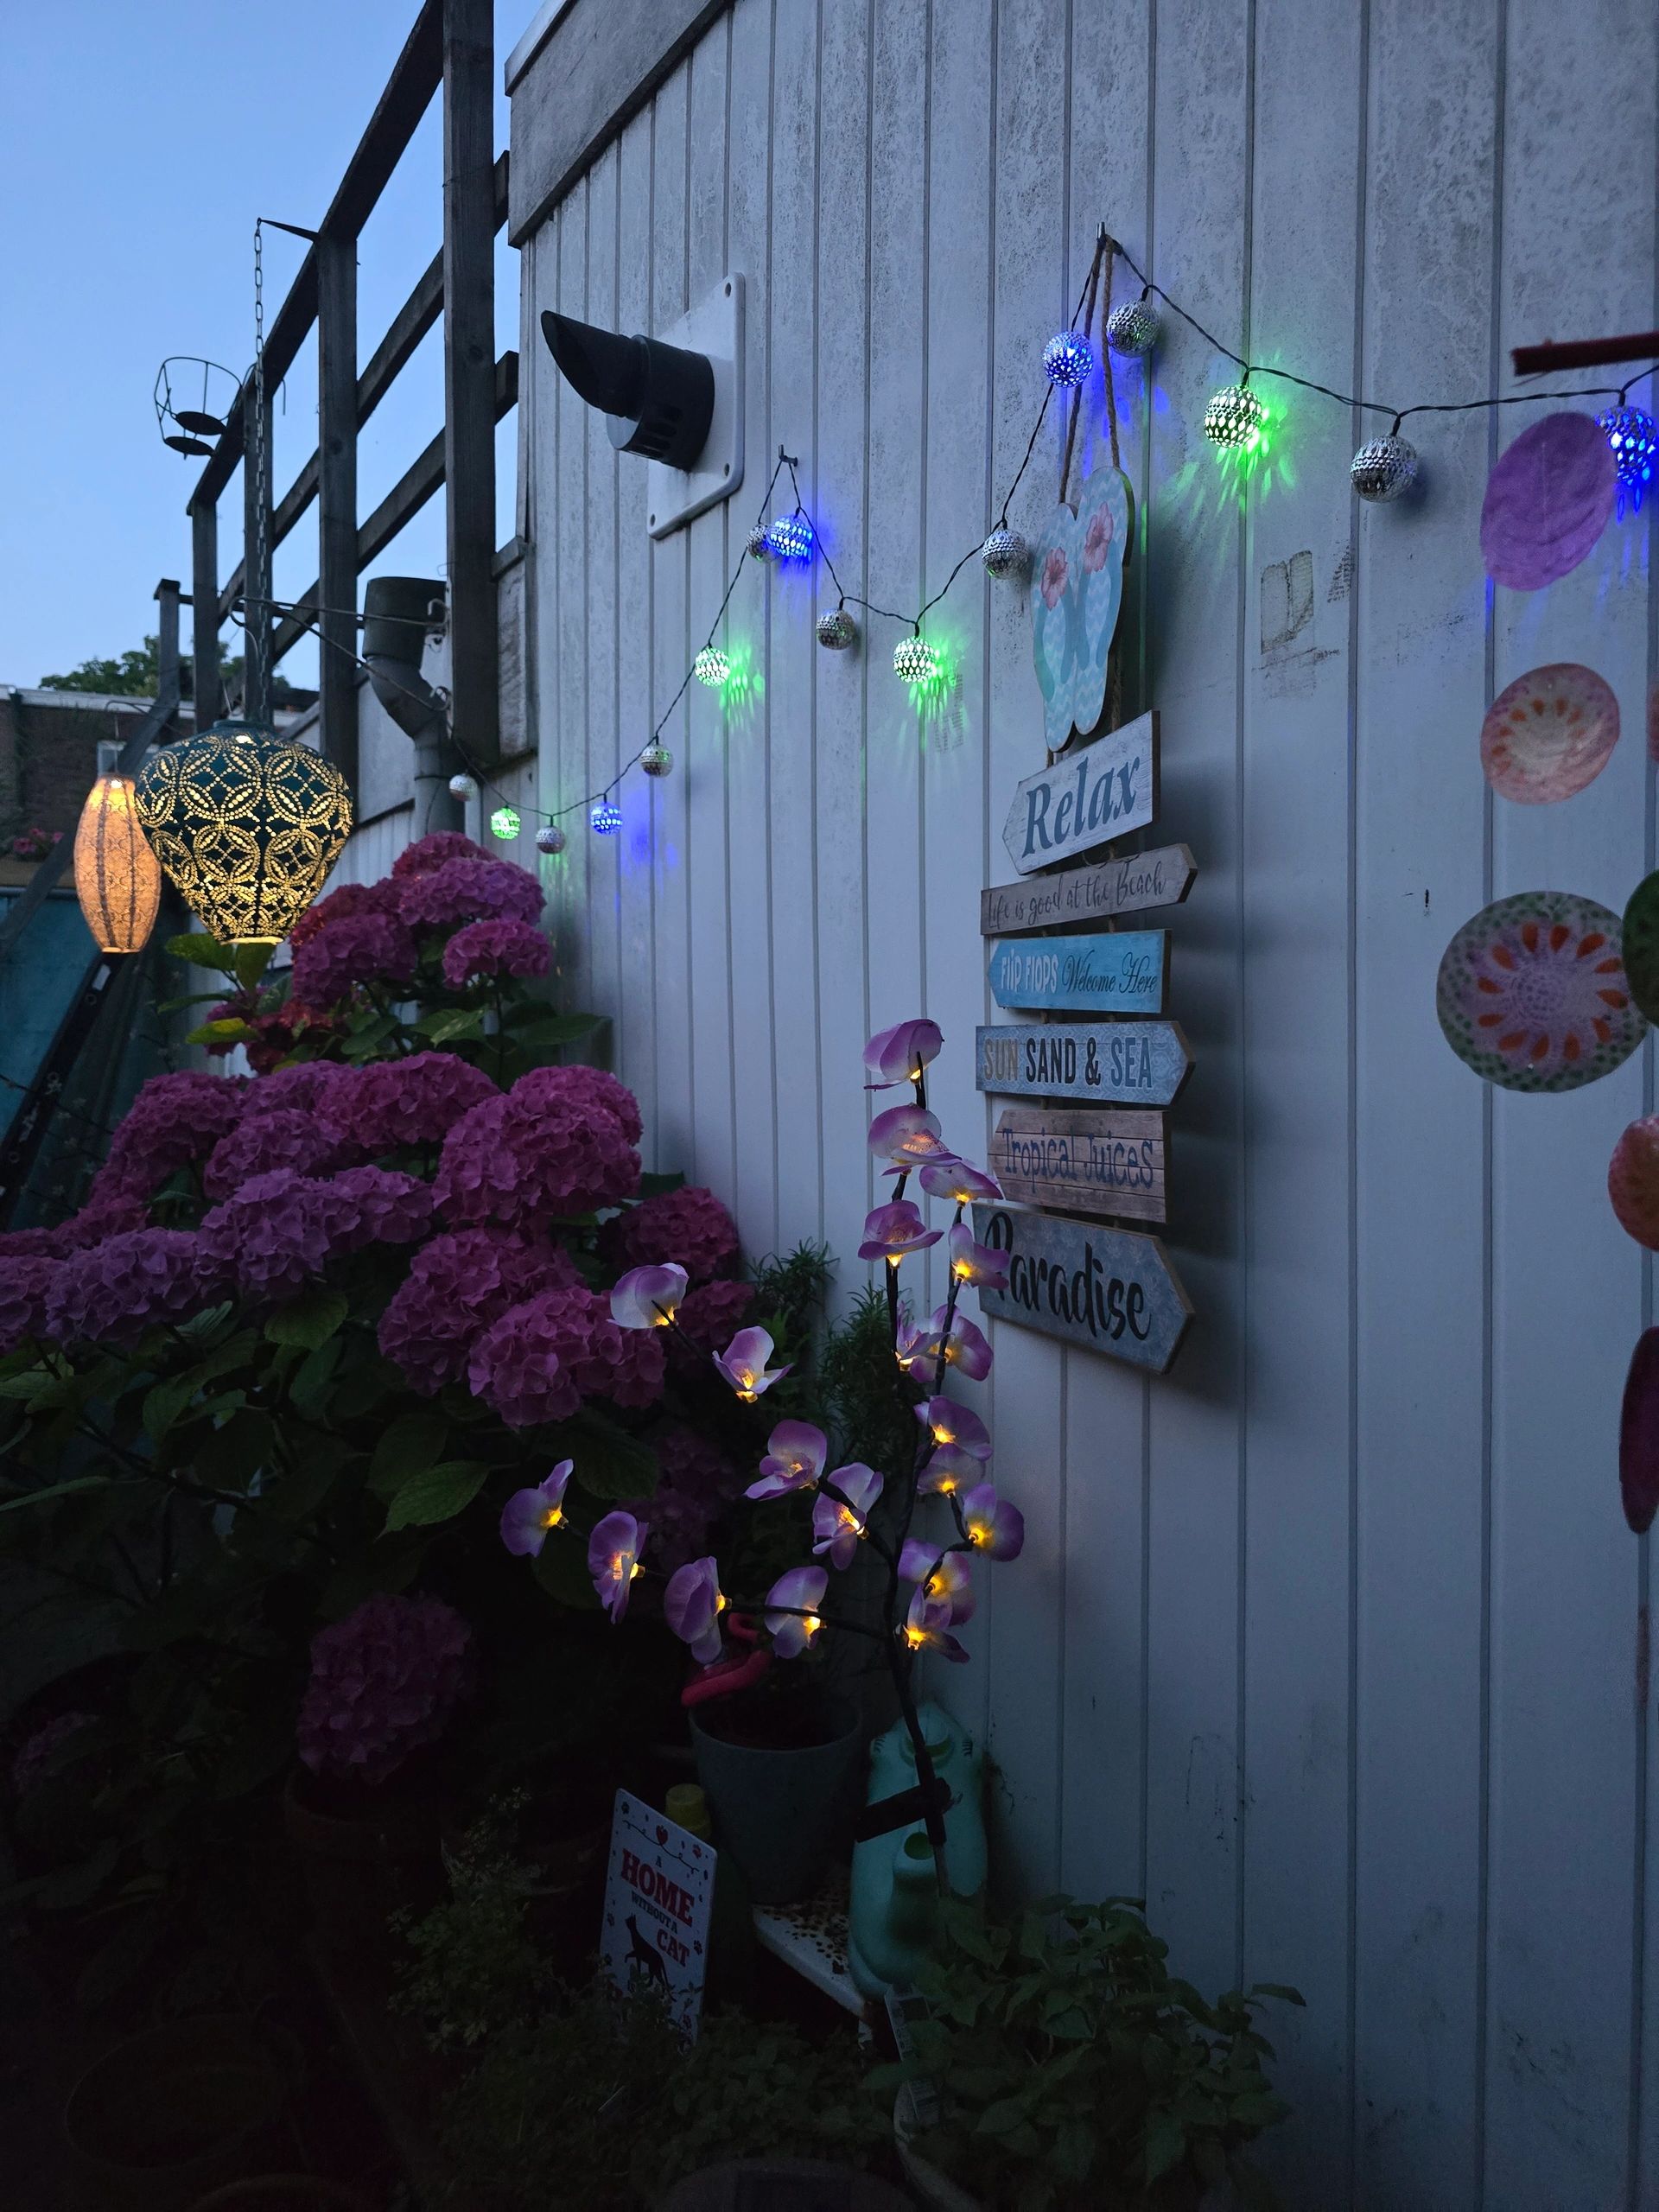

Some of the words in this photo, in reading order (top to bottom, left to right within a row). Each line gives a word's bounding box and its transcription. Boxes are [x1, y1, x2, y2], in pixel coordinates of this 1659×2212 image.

[1021, 756, 1140, 858] Relax
[988, 893, 1009, 929] Life
[1015, 899, 1024, 919] is
[1028, 874, 1063, 925] good
[1067, 883, 1080, 908] at
[1080, 874, 1108, 907] the
[1116, 861, 1166, 906] Beach
[1062, 950, 1116, 993] Welcome
[1119, 952, 1158, 994] Here
[984, 1038, 1019, 1081] SUN
[1026, 1038, 1076, 1084] SAND
[1085, 1037, 1101, 1086] &
[1110, 1037, 1152, 1088] SEA
[1002, 1127, 1076, 1193] Tropical
[984, 1211, 1151, 1340] Paradise
[620, 1847, 695, 1928] HOME
[655, 1855, 663, 1868] A
[632, 1890, 671, 1928] WITHOUT
[671, 1921, 677, 1935] A
[657, 1928, 690, 1967] CAT
